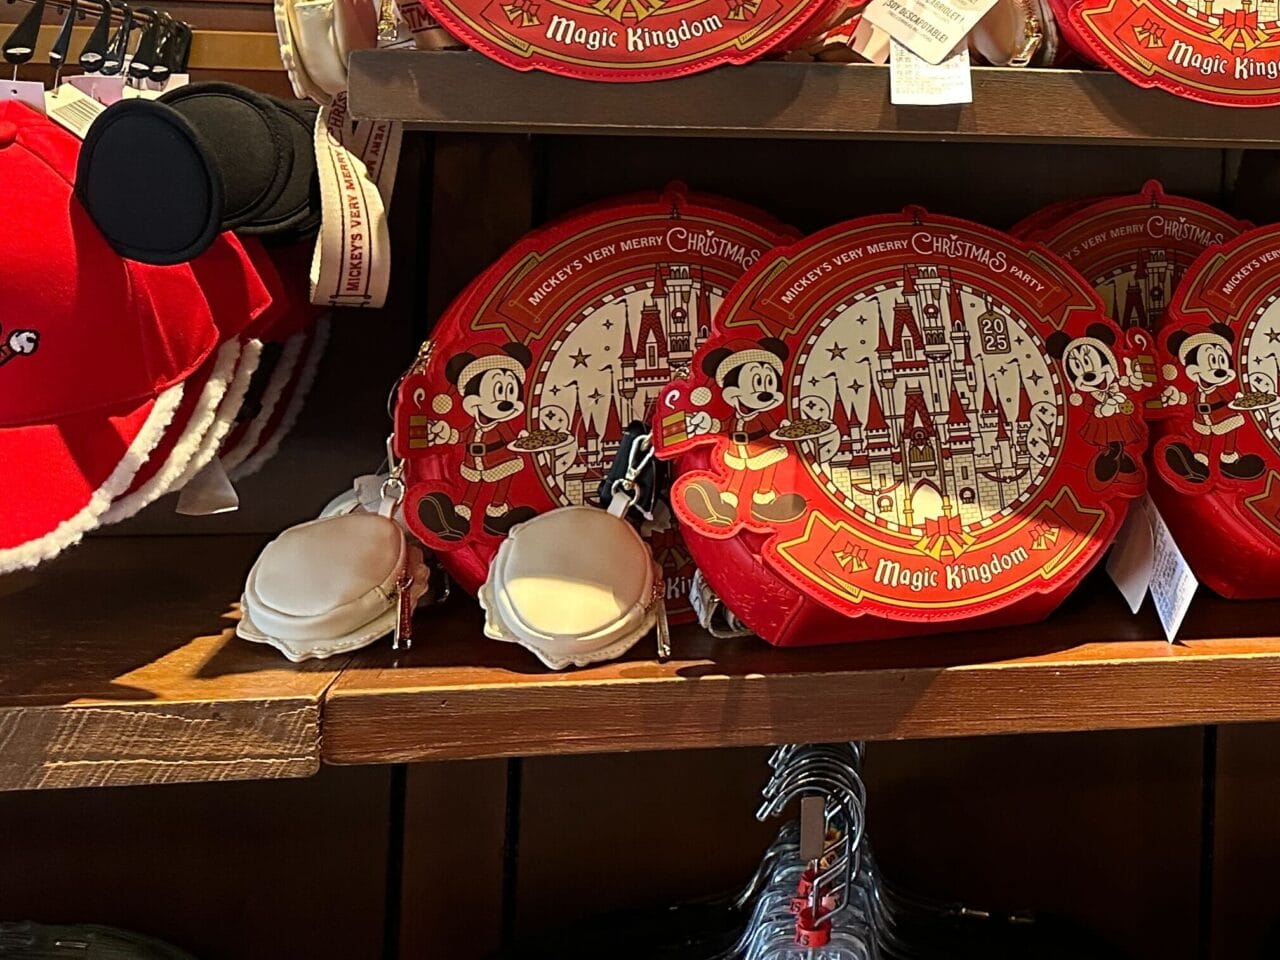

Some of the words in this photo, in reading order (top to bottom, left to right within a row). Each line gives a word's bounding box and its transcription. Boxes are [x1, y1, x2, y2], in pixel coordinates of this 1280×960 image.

[546, 15, 618, 50] Magic
[626, 14, 723, 52] Kingdom
[1167, 40, 1228, 75] Magic
[336, 151, 356, 191] MERRY
[346, 195, 361, 228] VERY
[1081, 233, 1107, 250] VERY
[1109, 224, 1145, 239] MERRY
[347, 233, 362, 291] MICKEY'S
[528, 260, 583, 306] MICKEY'S
[584, 246, 617, 264] VERY
[620, 235, 663, 252] MERRY
[666, 227, 761, 272] CHRISTMAS
[781, 262, 832, 304] MICKEY'S
[832, 249, 864, 267] VERY
[866, 239, 908, 255] MERRY
[911, 232, 1007, 273] CHRISTMAS
[1010, 265, 1045, 293] PARTY
[1222, 259, 1260, 295] MICKEY'S
[982, 319, 1004, 334] 20
[985, 335, 1007, 350] 25
[874, 558, 938, 591] Magic
[944, 546, 1029, 590] Kingdom
